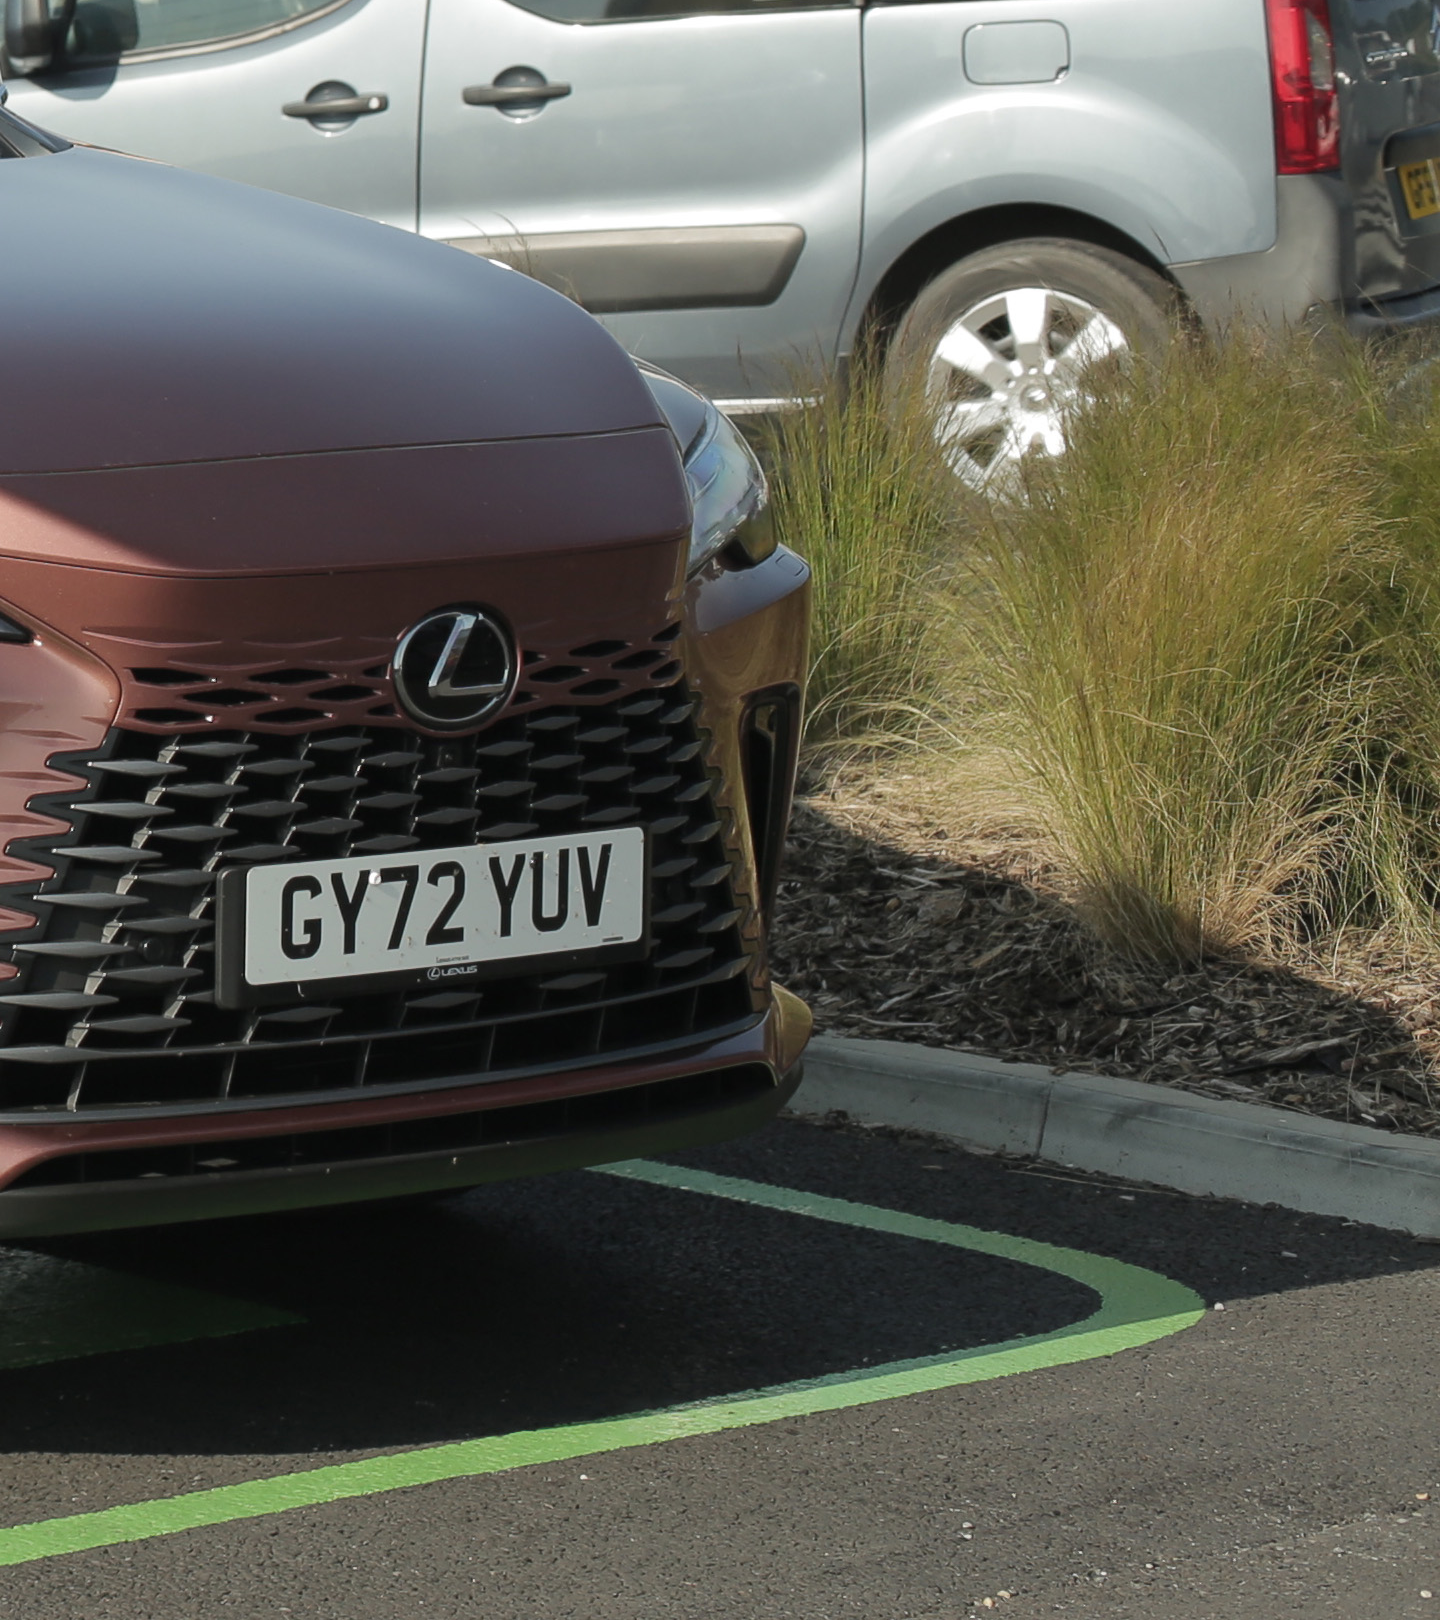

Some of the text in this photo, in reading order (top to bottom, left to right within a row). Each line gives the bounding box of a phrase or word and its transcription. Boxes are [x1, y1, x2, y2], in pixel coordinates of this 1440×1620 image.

[281, 843, 613, 961] GY72 YUV
[441, 964, 478, 977] LEXUS
